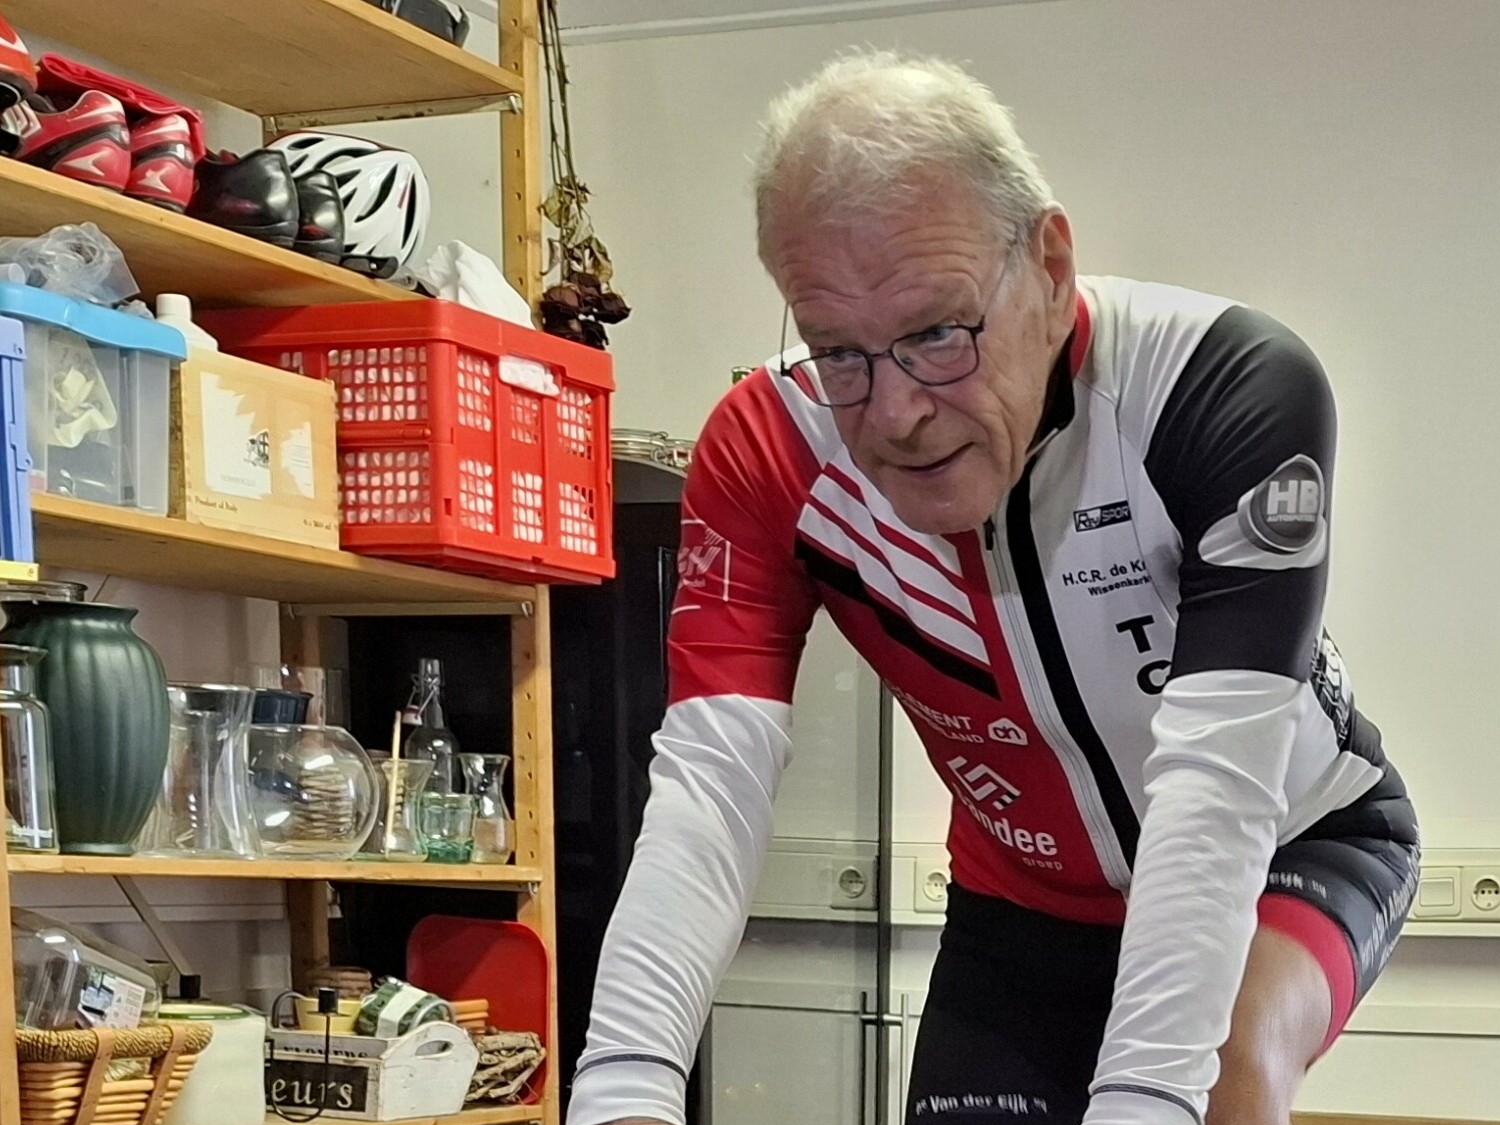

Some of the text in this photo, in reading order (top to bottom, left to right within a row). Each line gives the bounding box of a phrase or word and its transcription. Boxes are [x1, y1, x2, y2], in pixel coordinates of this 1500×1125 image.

[1266, 480, 1319, 515] HB
[1101, 505, 1129, 522] SPOR
[1062, 568, 1106, 586] H.C.R.
[1109, 564, 1127, 577] de
[268, 1075, 353, 1108] eurs
